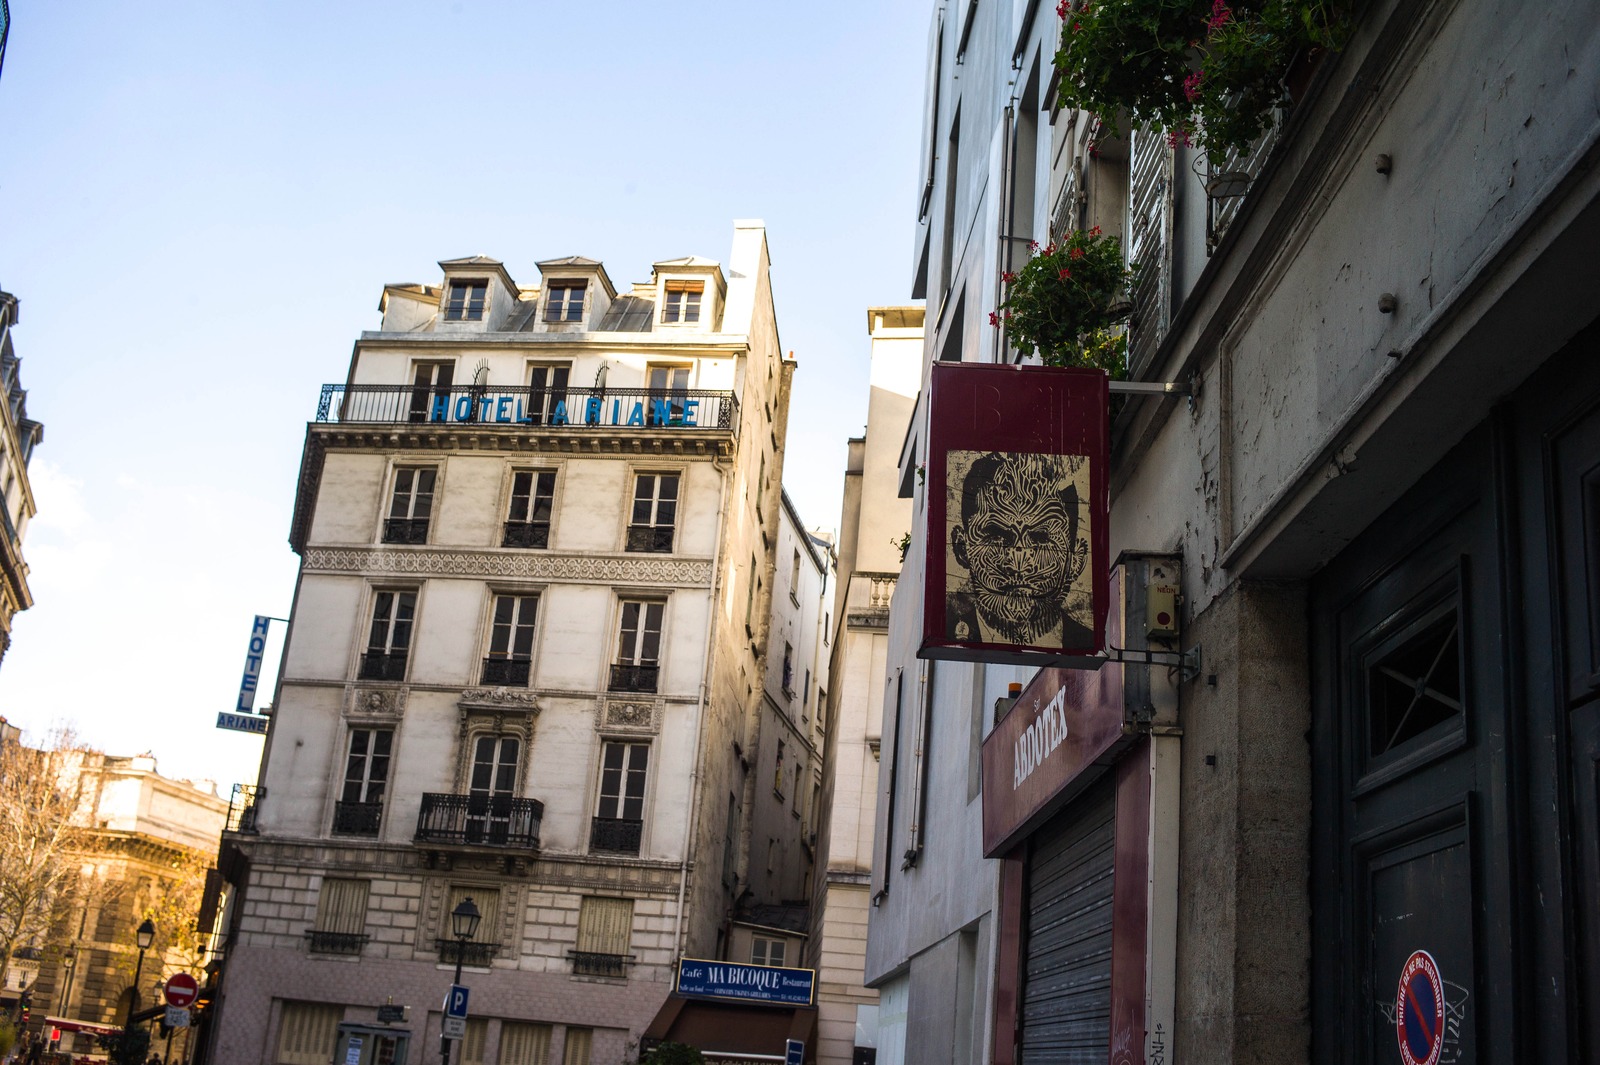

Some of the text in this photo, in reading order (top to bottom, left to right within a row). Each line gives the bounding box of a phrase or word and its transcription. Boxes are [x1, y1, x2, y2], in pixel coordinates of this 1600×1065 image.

[431, 395, 700, 427] HOTEL ARIANE
[238, 616, 269, 711] HOTEL
[218, 715, 267, 732] ARIANE
[1013, 685, 1068, 791] ABDOTEX
[682, 967, 811, 991] Café MA BICOQUE Restaurant
[1404, 971, 1410, 986] DE
[1409, 961, 1415, 975] NE
[1425, 960, 1442, 1017] STATIONNER
[454, 992, 463, 1010] P
